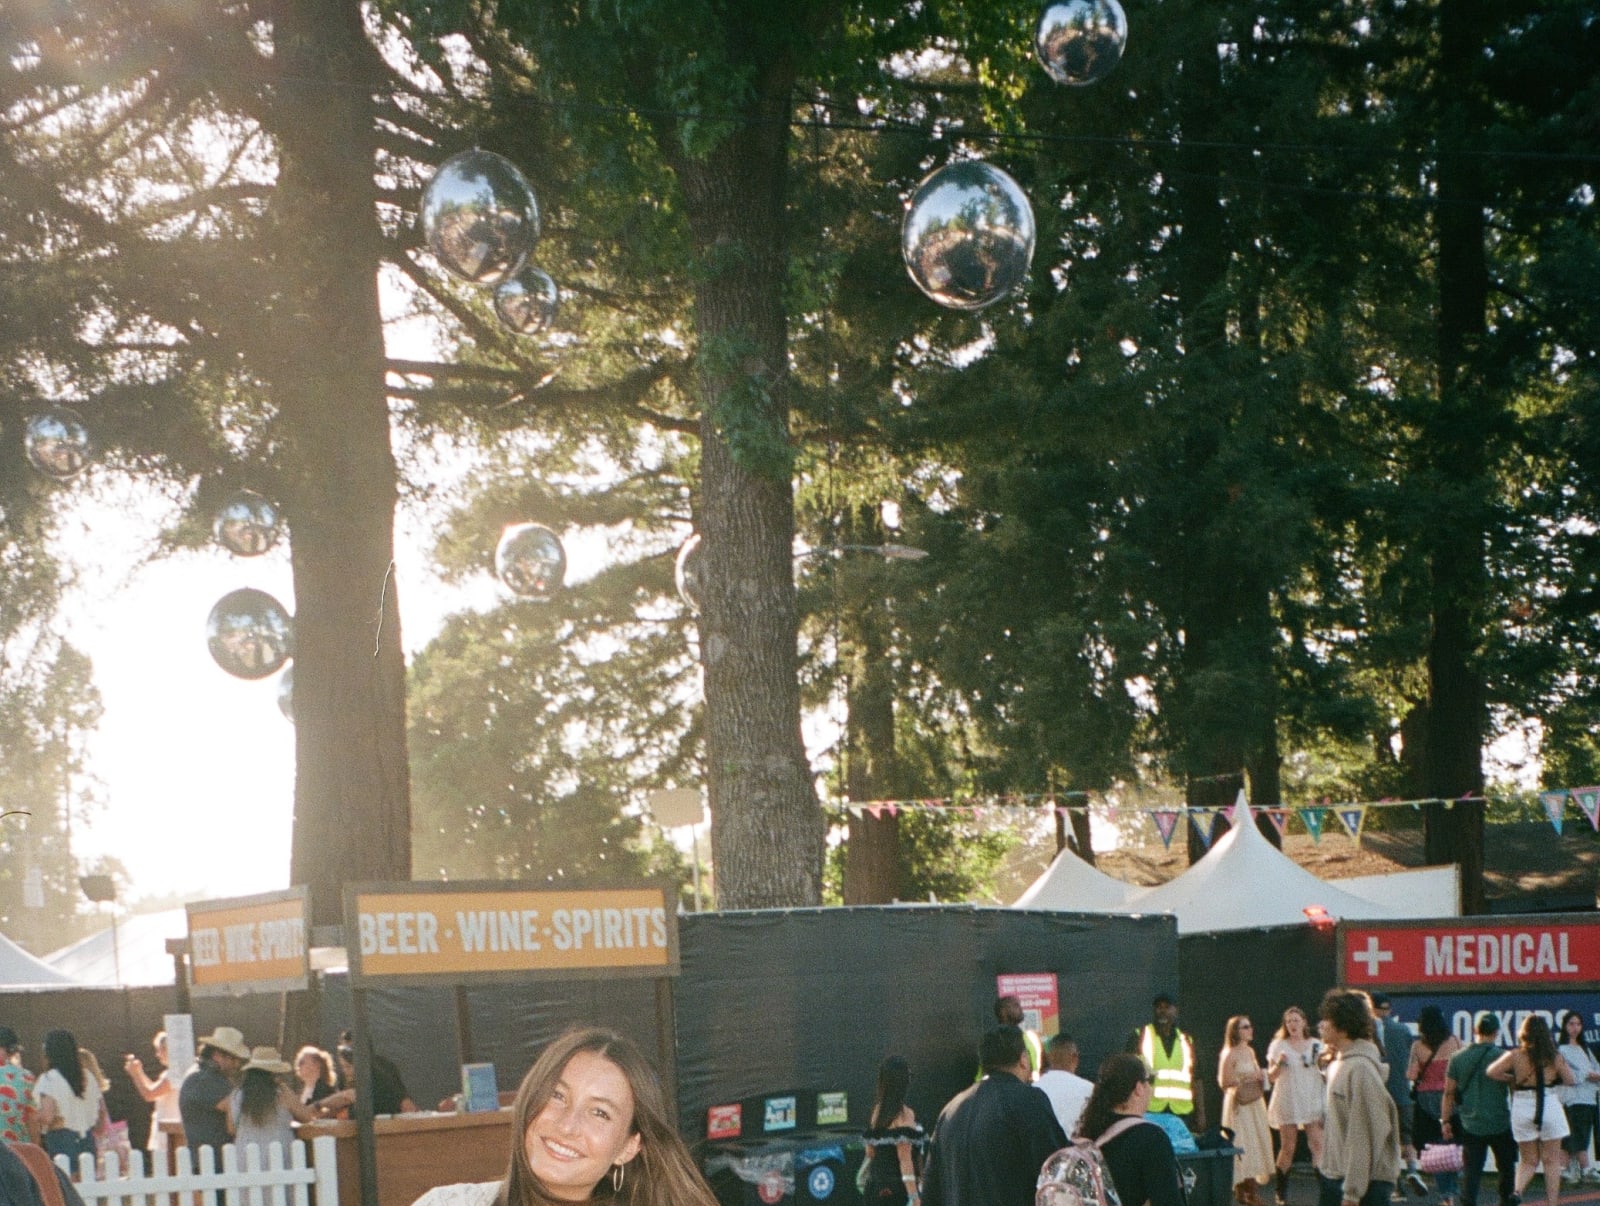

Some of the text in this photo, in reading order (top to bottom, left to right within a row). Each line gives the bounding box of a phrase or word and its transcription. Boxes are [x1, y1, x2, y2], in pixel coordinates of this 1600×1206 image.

[358, 907, 668, 956] BEER WINE SPIRITS
[1424, 932, 1578, 976] MEDICAL
